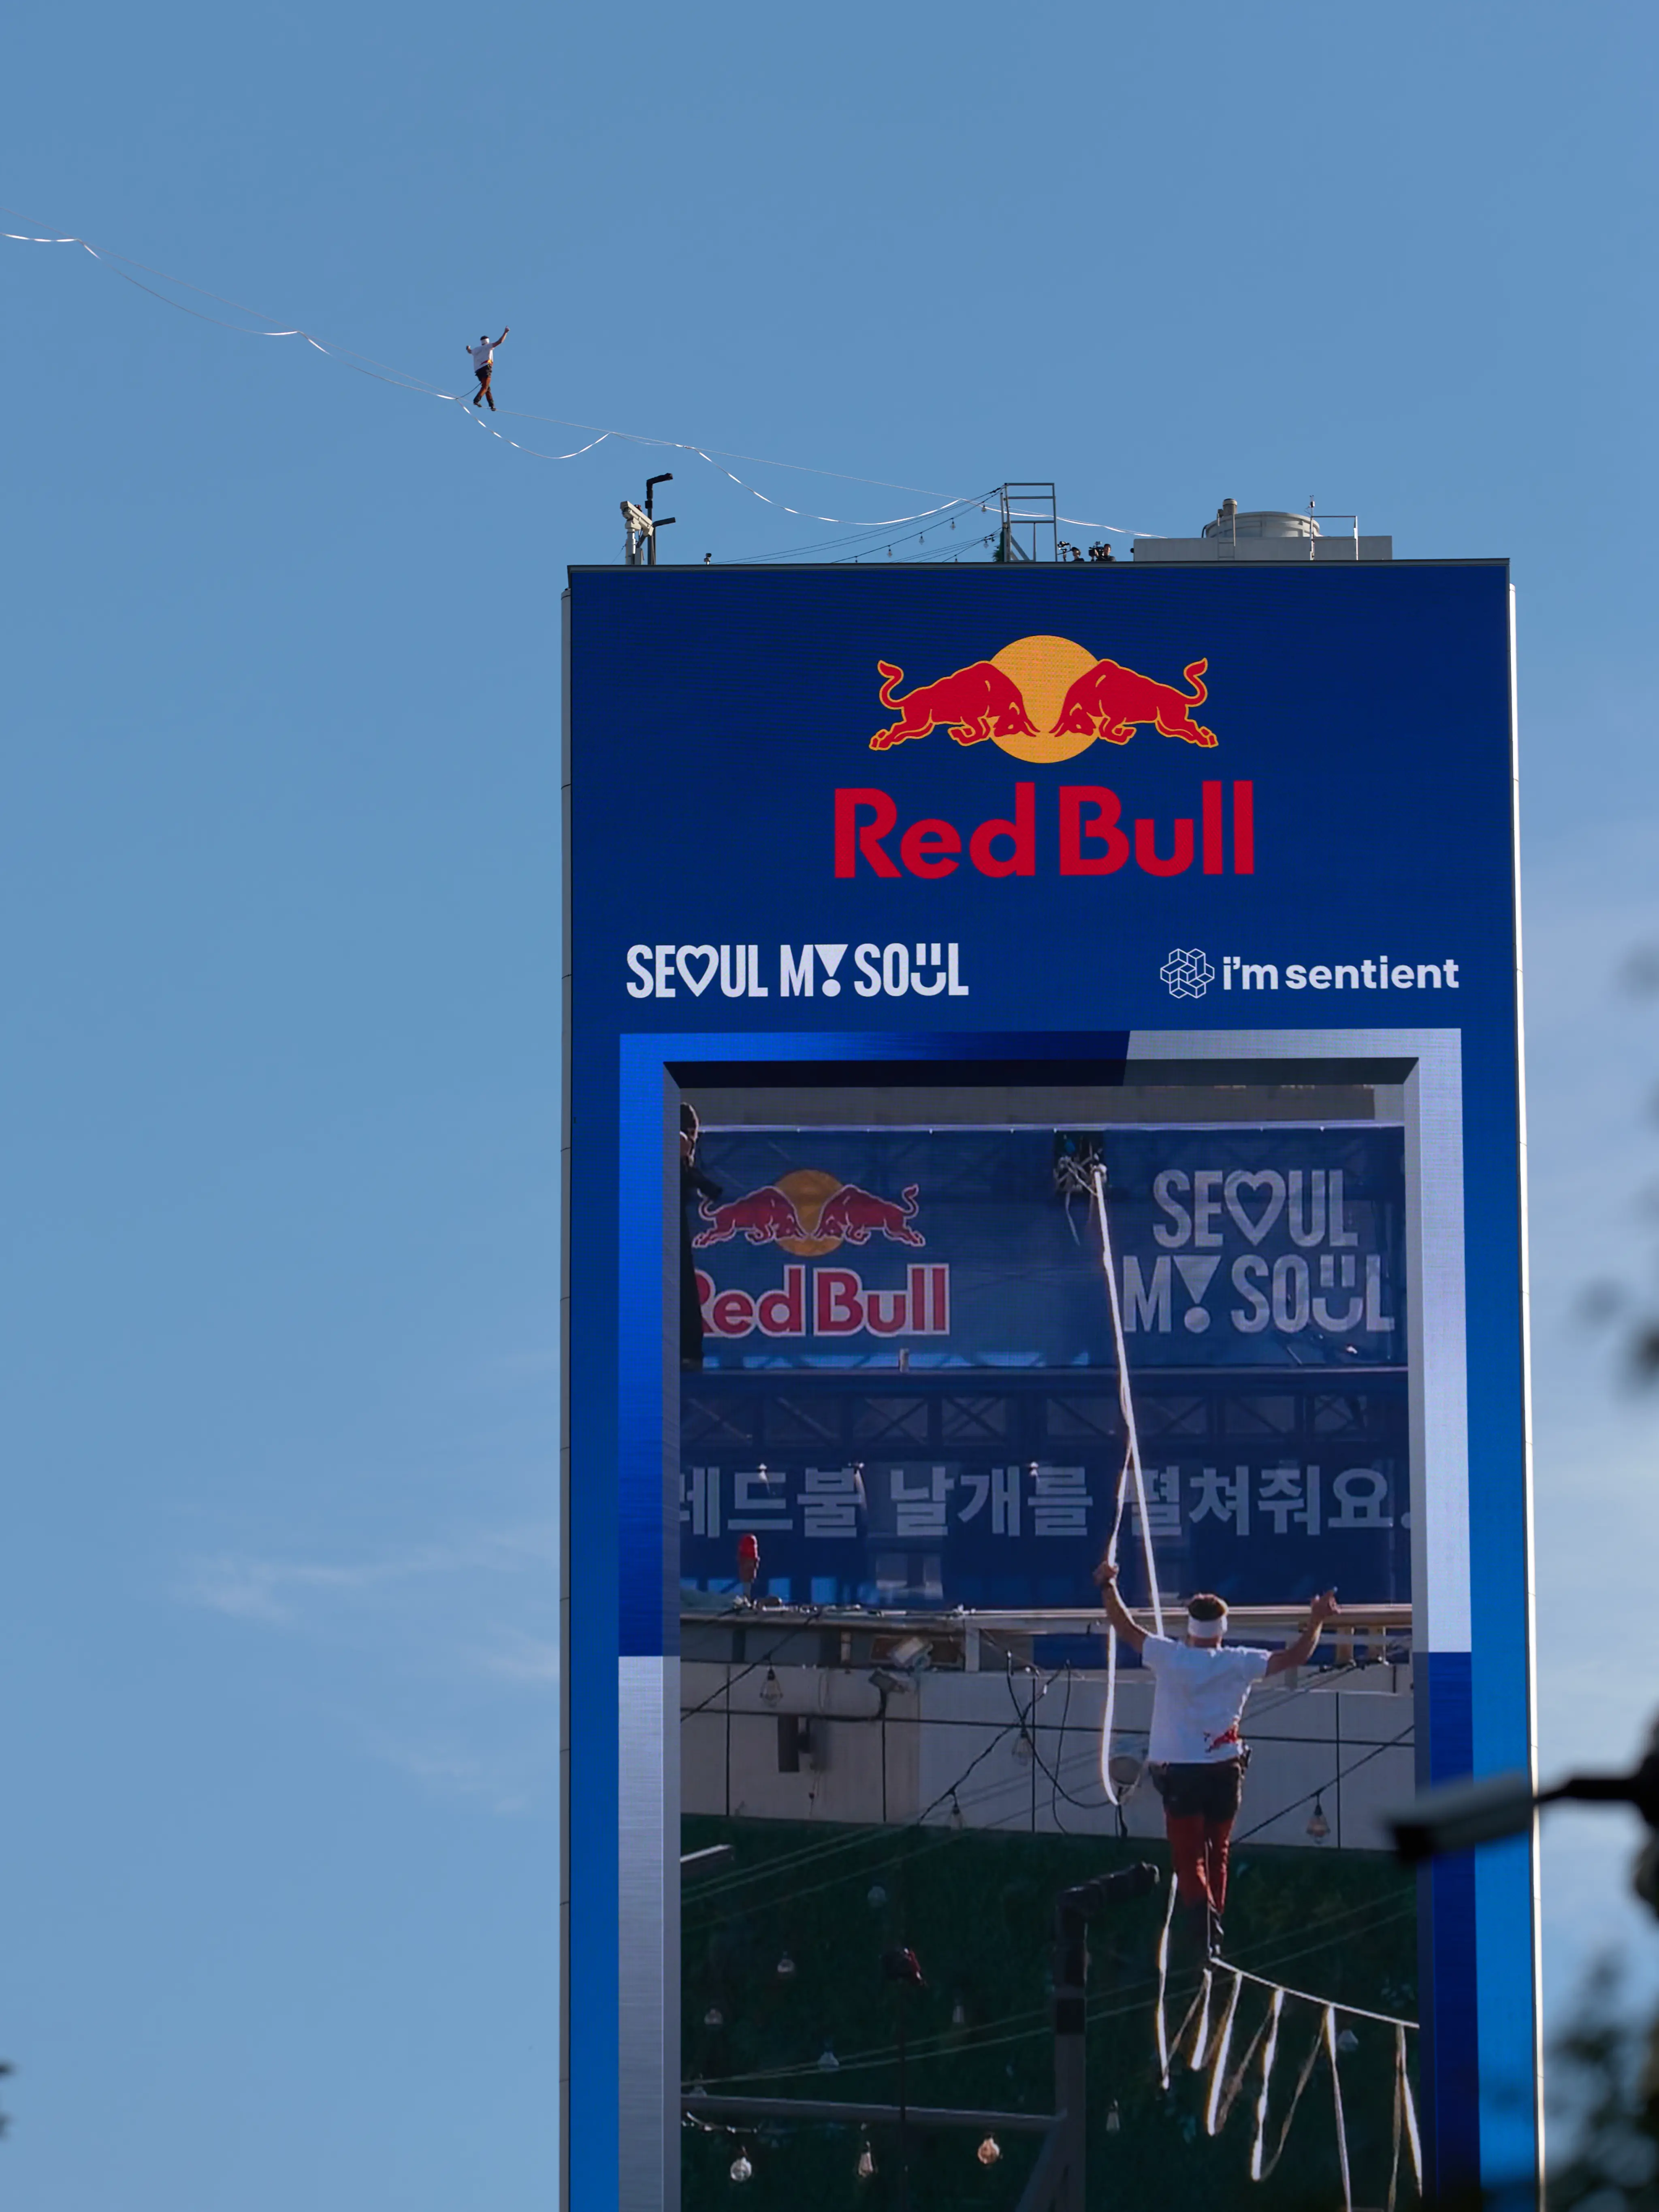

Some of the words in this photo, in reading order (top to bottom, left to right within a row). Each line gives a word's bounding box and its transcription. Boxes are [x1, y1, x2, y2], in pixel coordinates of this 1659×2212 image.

[835, 782, 1034, 878] Red
[1060, 781, 1253, 876] Bull
[627, 944, 769, 998] SEOUL
[854, 943, 969, 997] SOUL
[1285, 955, 1459, 989] sentient
[1153, 1170, 1358, 1248] SEOUL
[813, 1263, 950, 1337] Bull
[1231, 1254, 1395, 1333] SOUL
[891, 1466, 1093, 1537] 날개를
